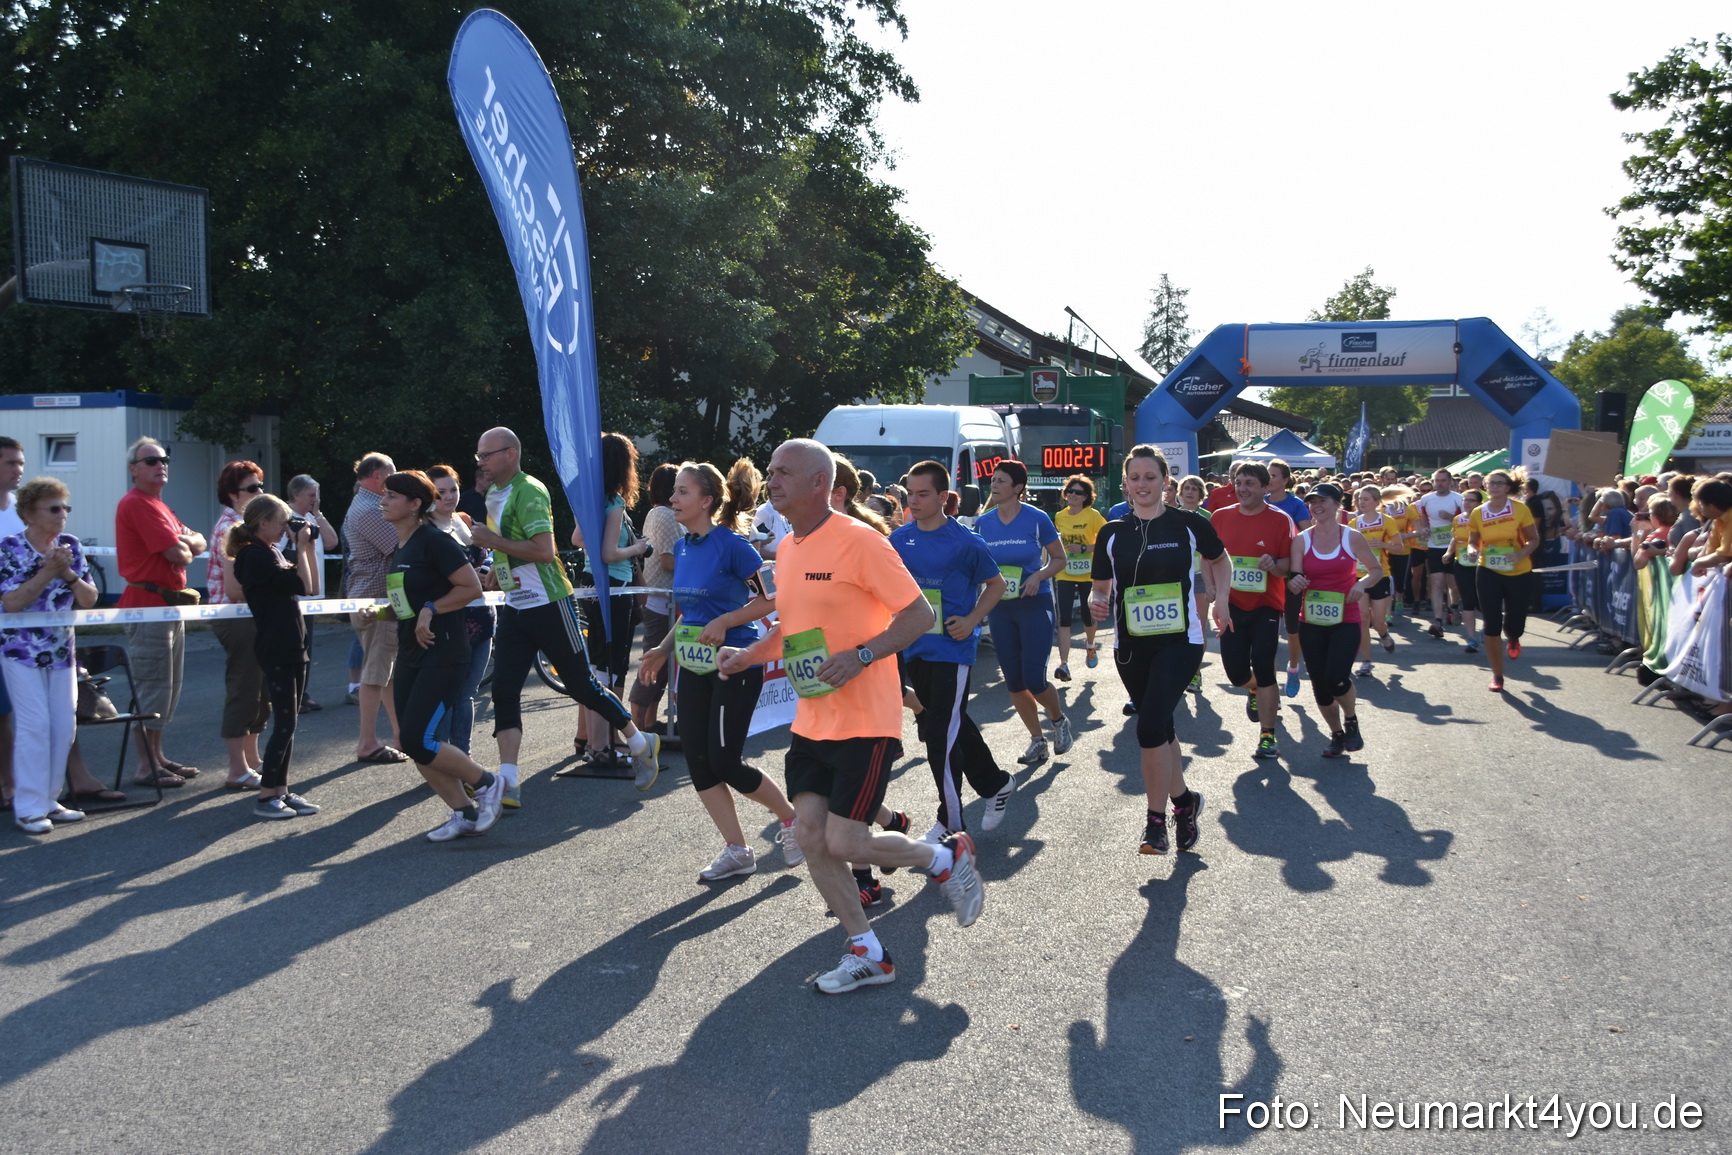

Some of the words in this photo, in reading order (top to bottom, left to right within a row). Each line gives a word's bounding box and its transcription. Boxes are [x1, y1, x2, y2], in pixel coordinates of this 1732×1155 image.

[1328, 352, 1407, 367] firmenlauf
[1182, 382, 1223, 391] Fischer
[1630, 434, 1659, 463] AOK
[1044, 447, 1104, 468] 000221
[1437, 532, 1451, 540] 826
[1067, 560, 1090, 570] 1528
[1490, 556, 1507, 566] 871
[805, 572, 832, 581] THULE
[1232, 570, 1263, 583] 1369
[1132, 603, 1179, 622] 1085
[1308, 604, 1339, 617] 1368
[679, 645, 713, 663] 1442
